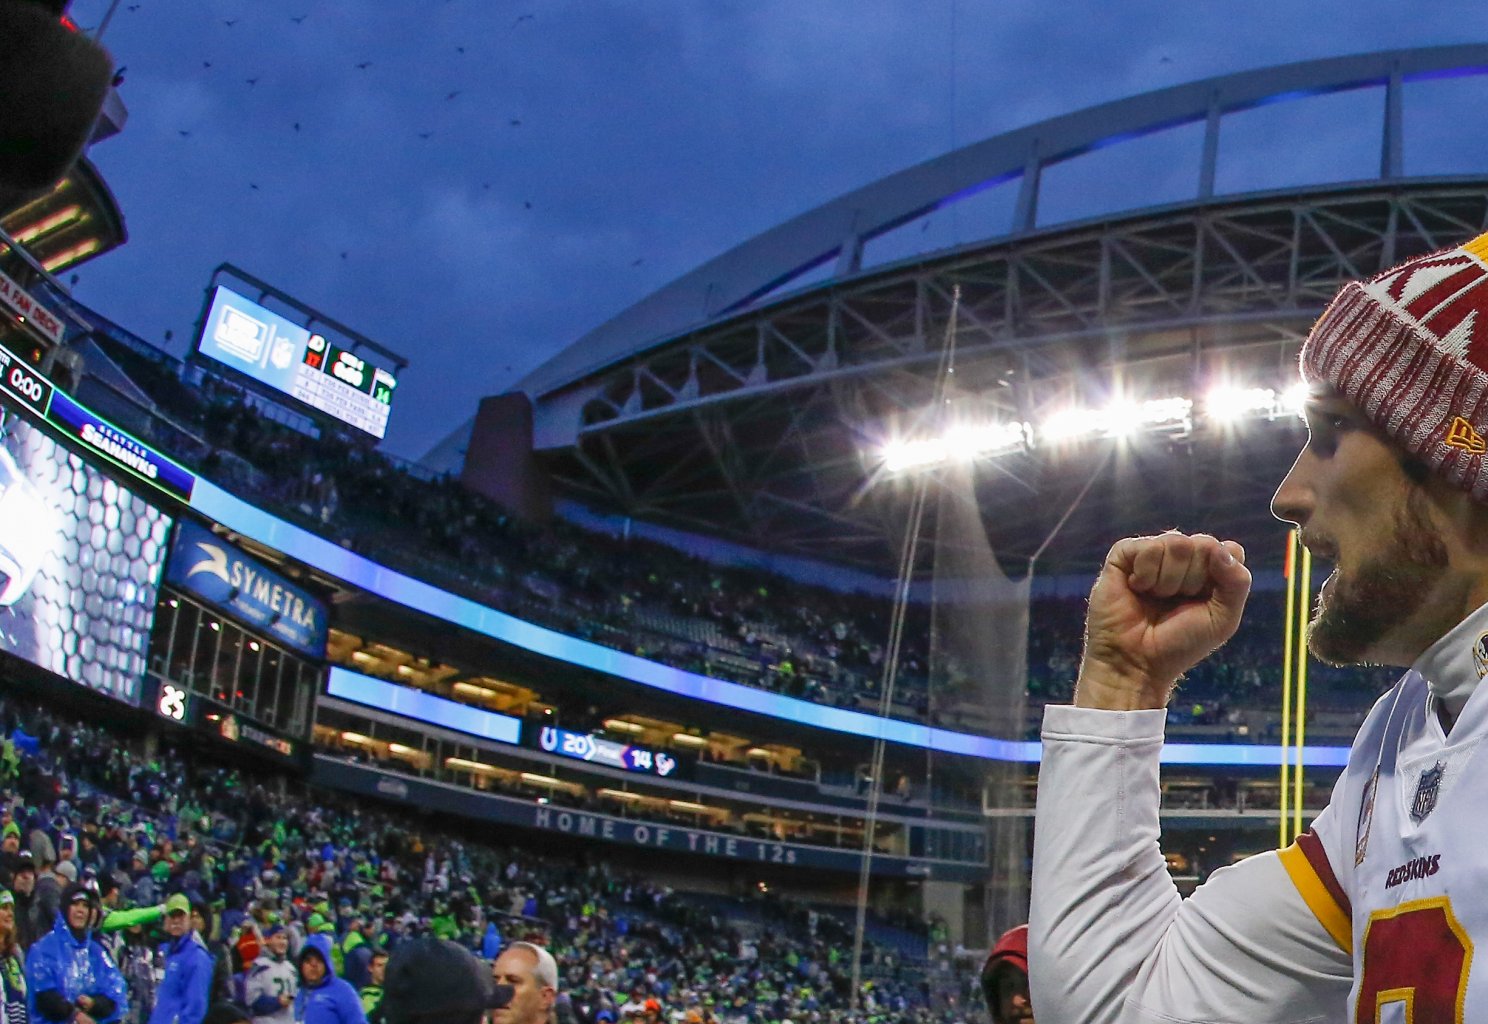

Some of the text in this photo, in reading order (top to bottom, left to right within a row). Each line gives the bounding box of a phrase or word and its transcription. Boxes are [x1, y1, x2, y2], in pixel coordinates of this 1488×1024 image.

[10, 368, 42, 401] 0:00
[81, 423, 158, 479] SEAHAWKS
[231, 560, 315, 631] SYMETRA
[563, 733, 588, 754] 20
[631, 749, 652, 769] 14
[535, 808, 796, 864] HOME OF THE 12s
[1385, 854, 1441, 889] REDSKINS
